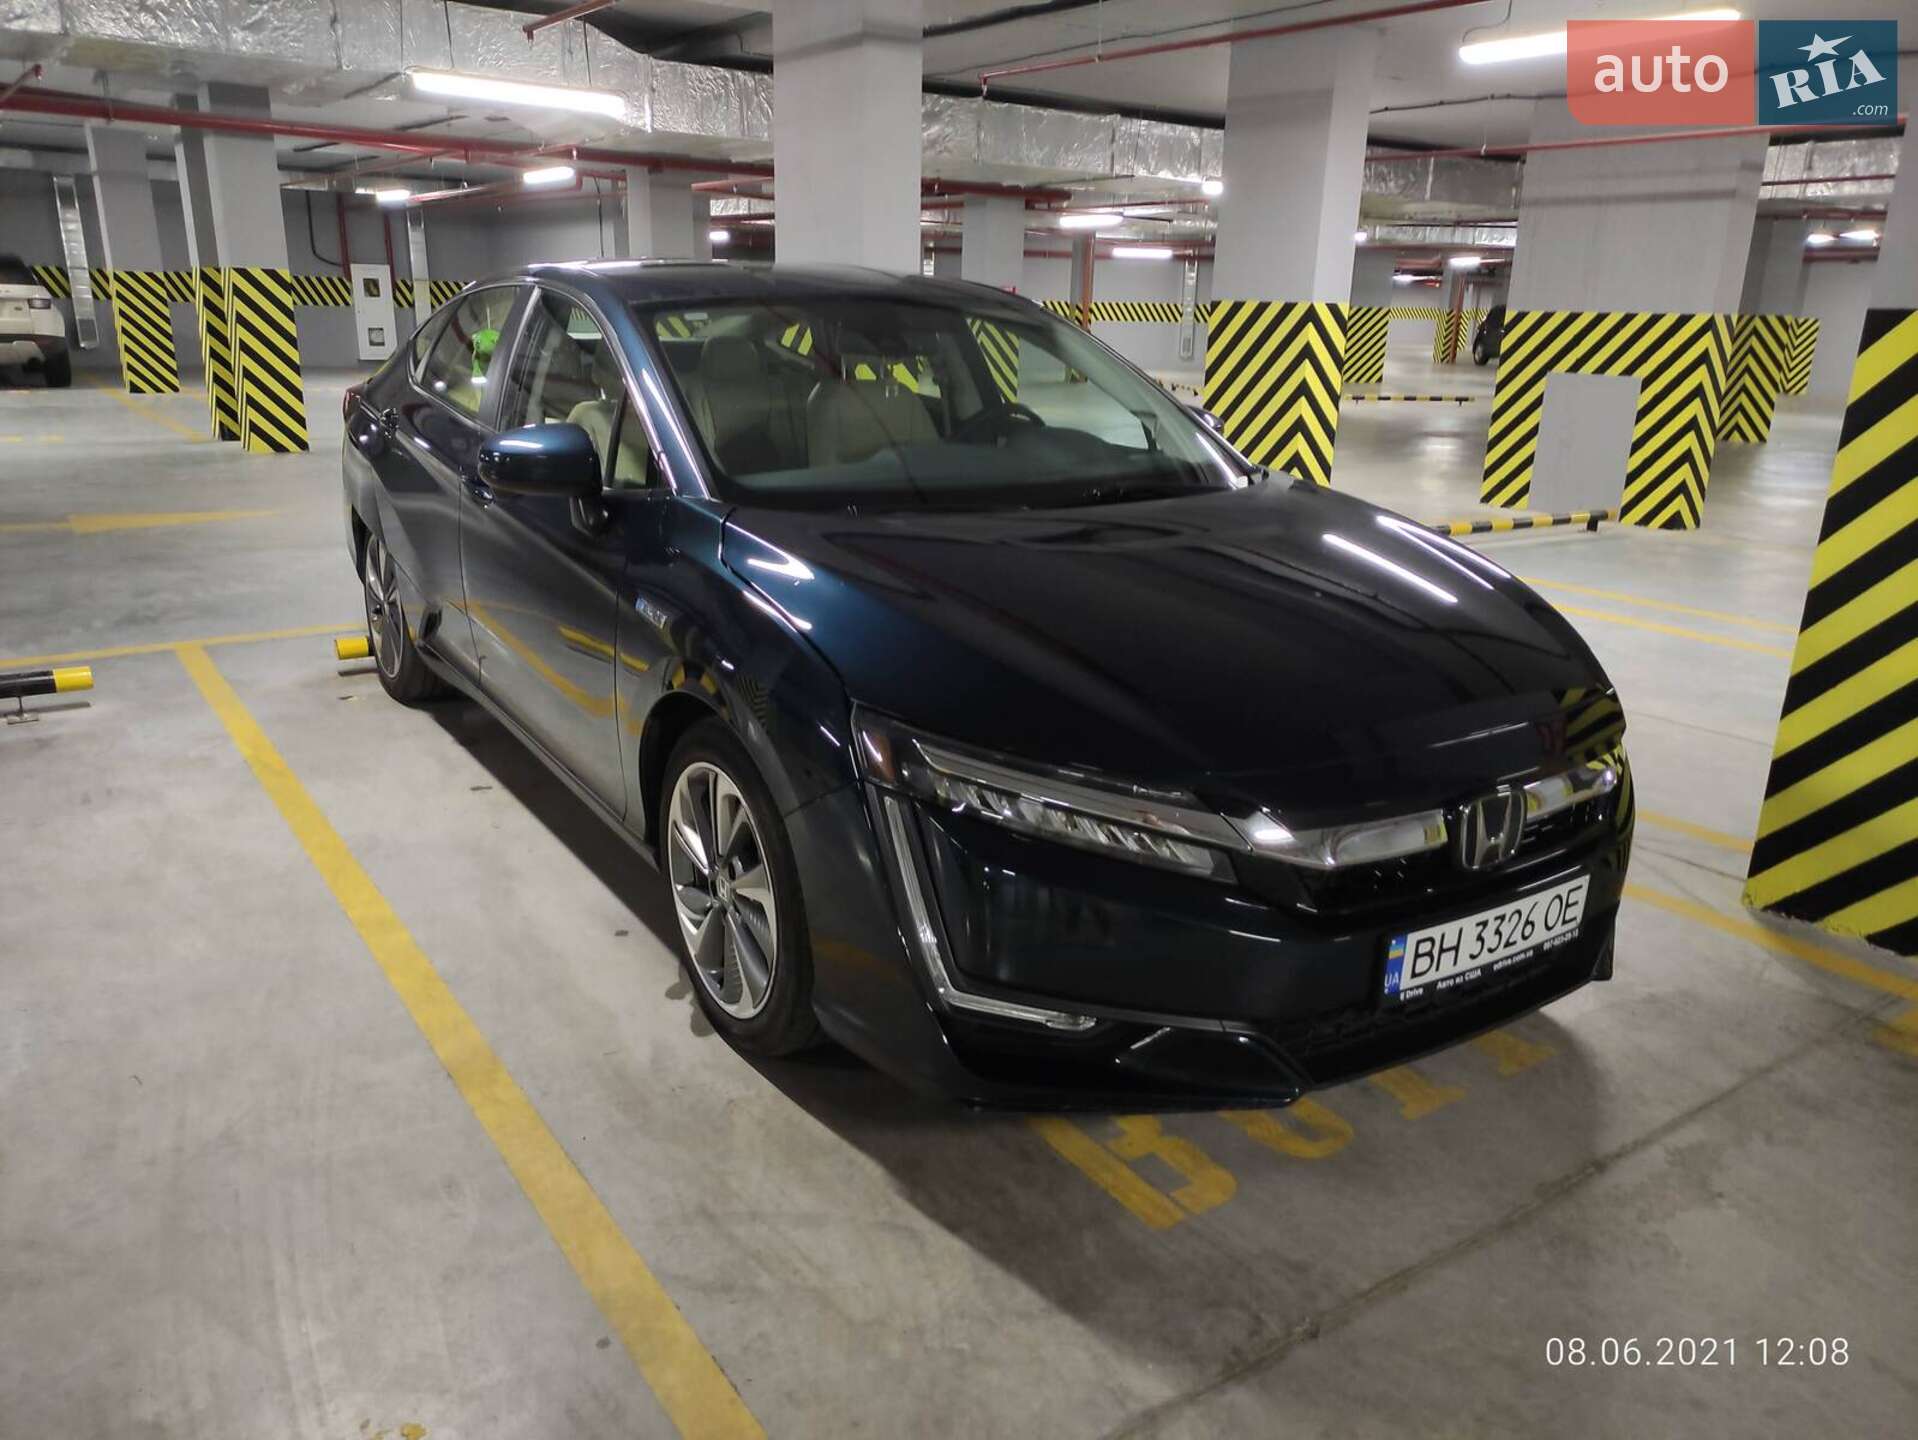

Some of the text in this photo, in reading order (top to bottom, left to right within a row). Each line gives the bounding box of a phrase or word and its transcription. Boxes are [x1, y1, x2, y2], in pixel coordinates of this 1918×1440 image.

[1410, 926, 1464, 980] BH
[1468, 901, 1540, 960] 3326
[1544, 884, 1584, 932] OE
[1384, 971, 1400, 988] UA
